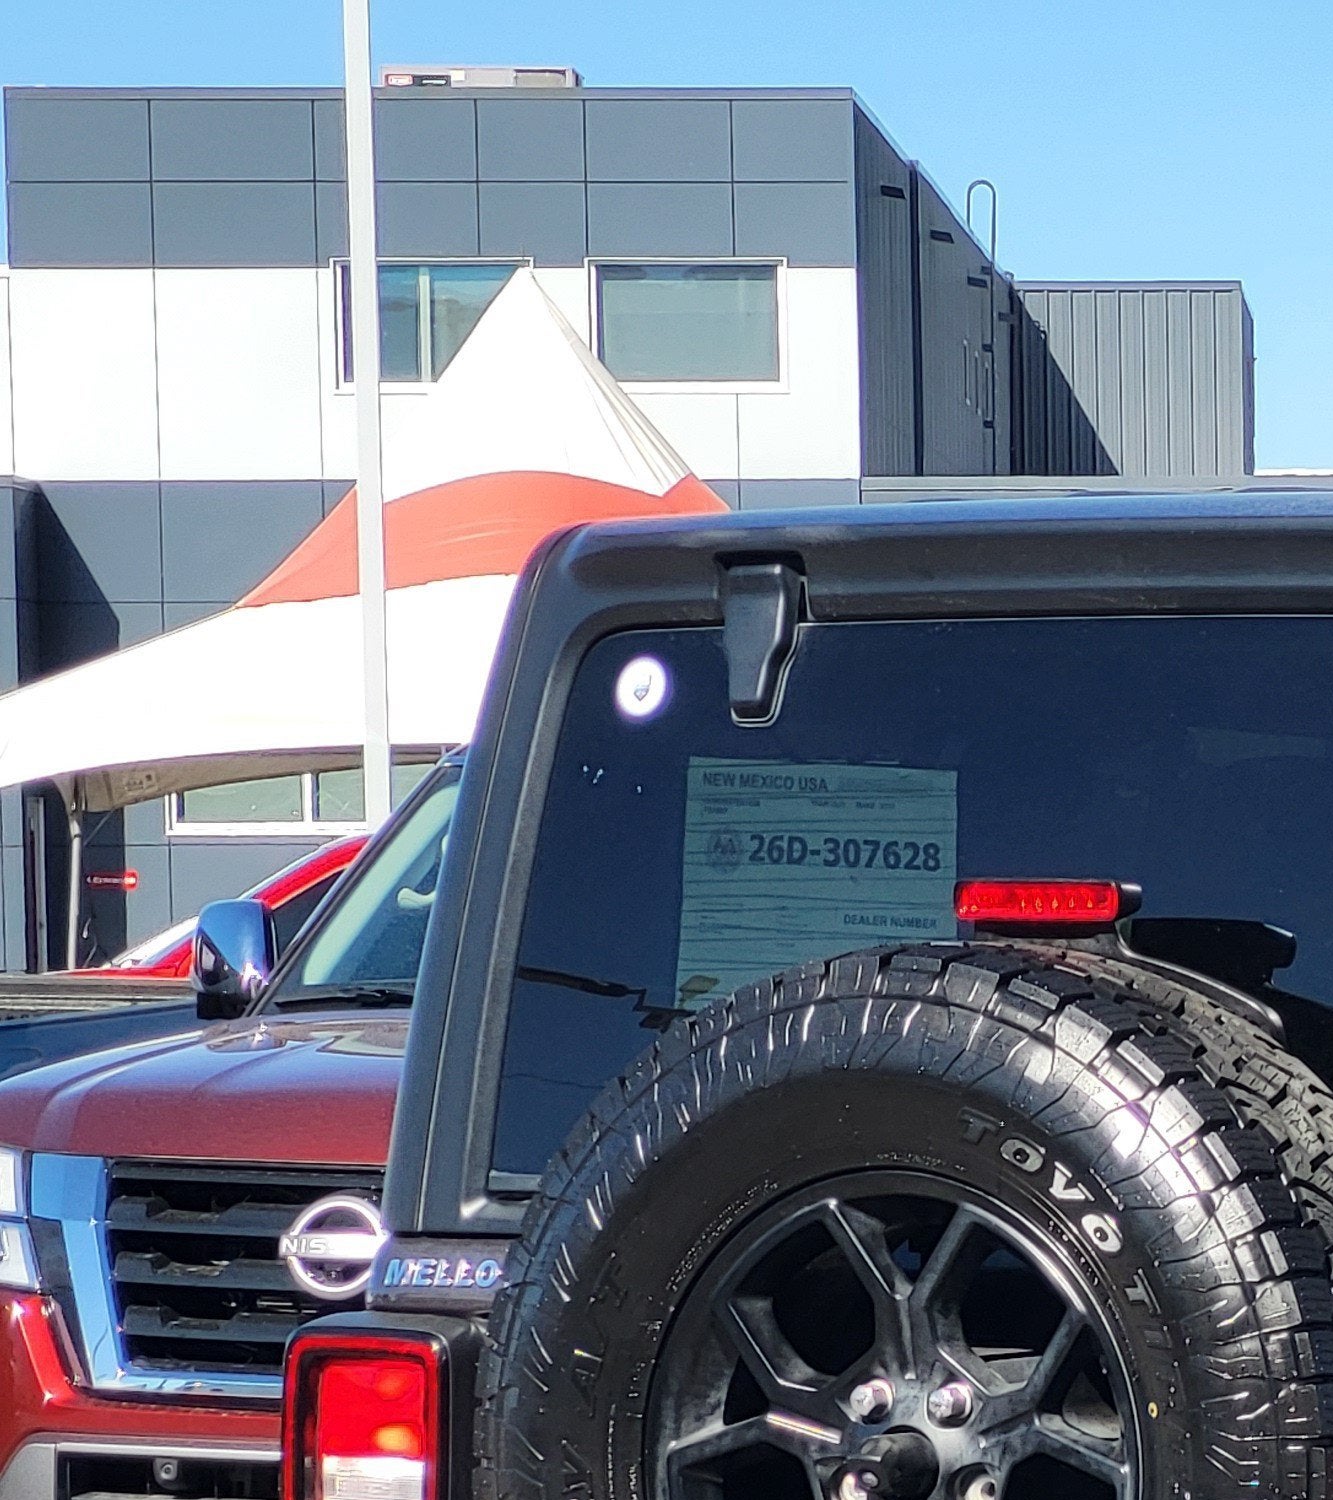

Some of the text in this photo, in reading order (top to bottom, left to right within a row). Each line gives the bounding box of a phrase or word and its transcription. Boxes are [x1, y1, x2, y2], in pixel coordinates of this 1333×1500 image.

[702, 771, 736, 788] NEW
[740, 772, 795, 791] MEXICO
[798, 774, 829, 792] USA
[748, 833, 942, 872] 26D-307628
[843, 914, 938, 929] DEALER NUMBER
[957, 1106, 1124, 1254] TOYO
[383, 1257, 499, 1288] MELLO
